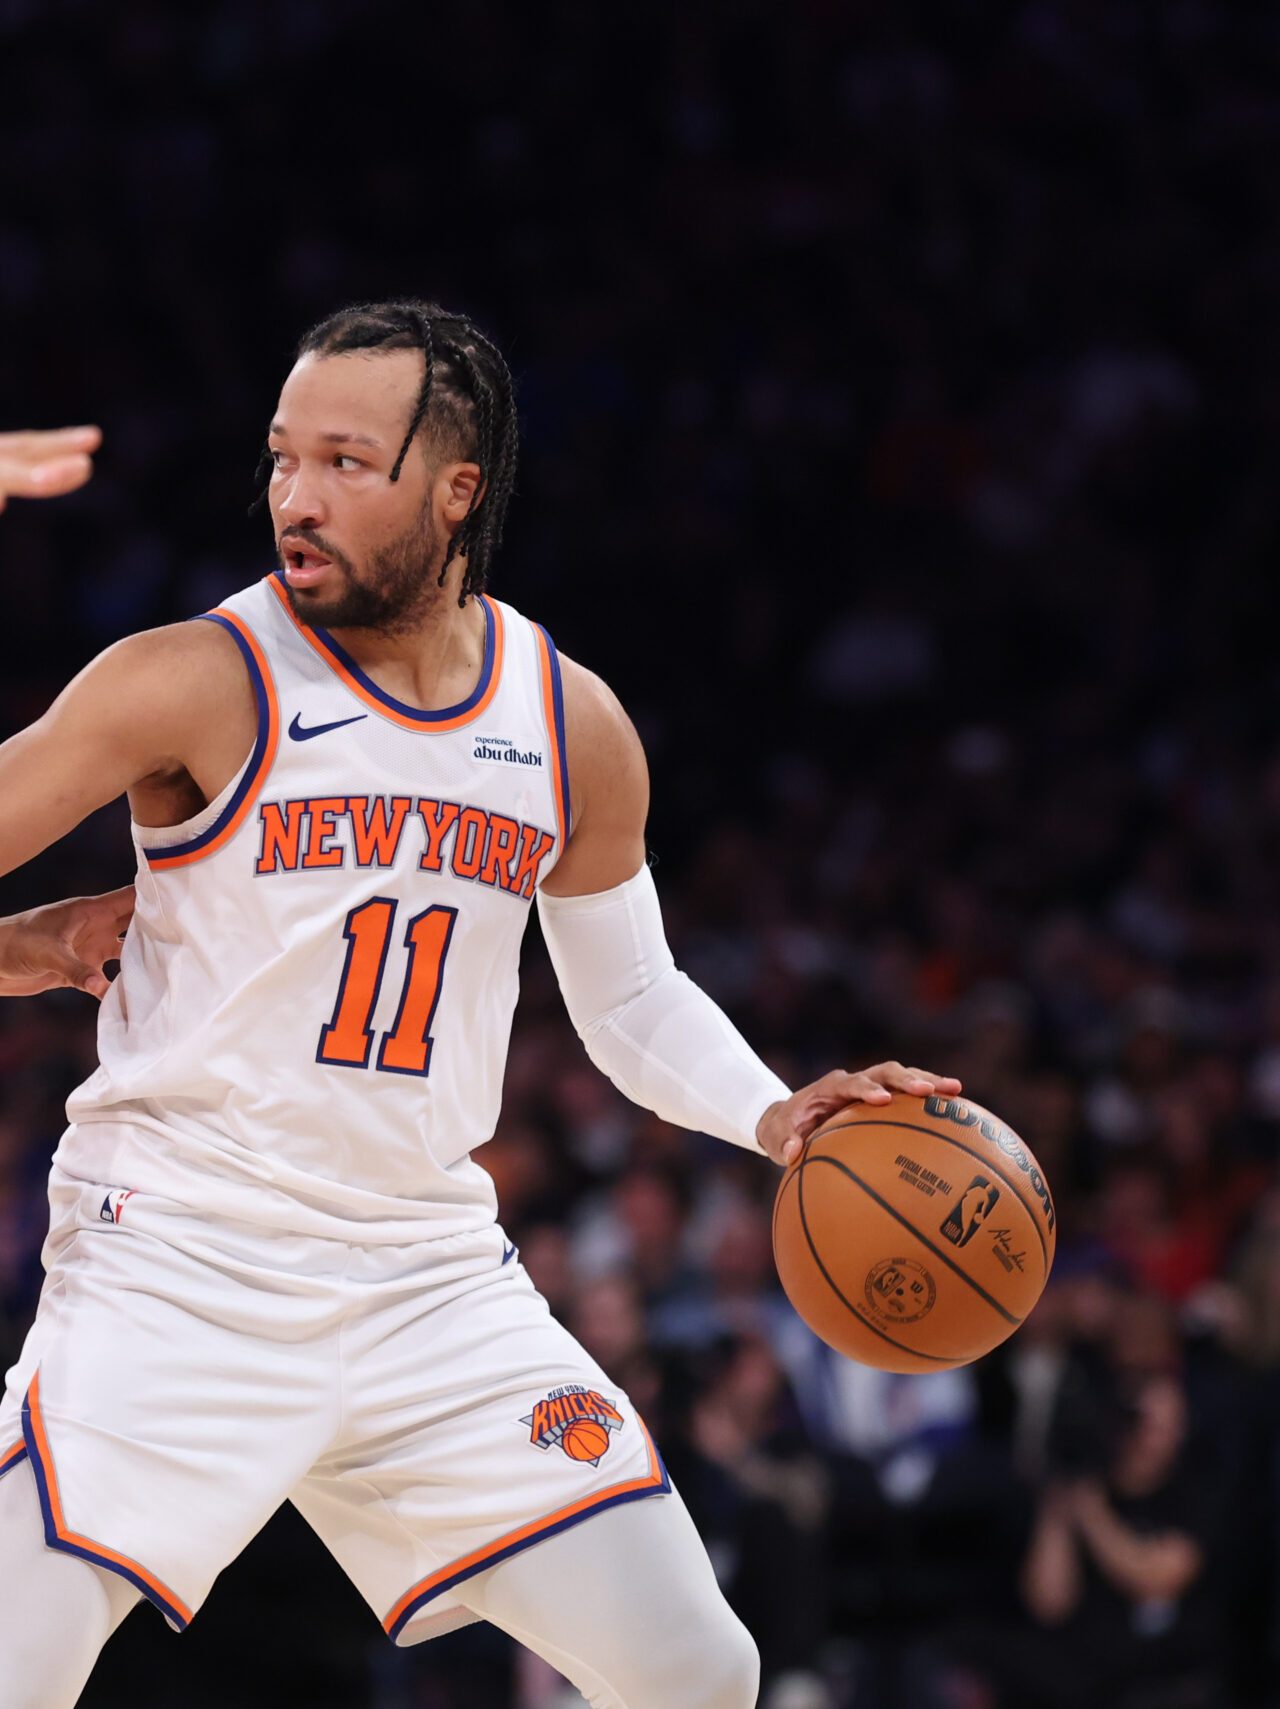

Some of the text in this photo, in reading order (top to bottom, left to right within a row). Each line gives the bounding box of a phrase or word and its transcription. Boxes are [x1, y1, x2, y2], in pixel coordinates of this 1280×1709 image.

[473, 745, 543, 767] abu dhabi
[474, 735, 513, 747] experience
[253, 794, 557, 901] NEW YORK
[314, 895, 459, 1078] 11
[547, 1384, 586, 1400] NEW YORK
[530, 1389, 624, 1448] KNICKS
